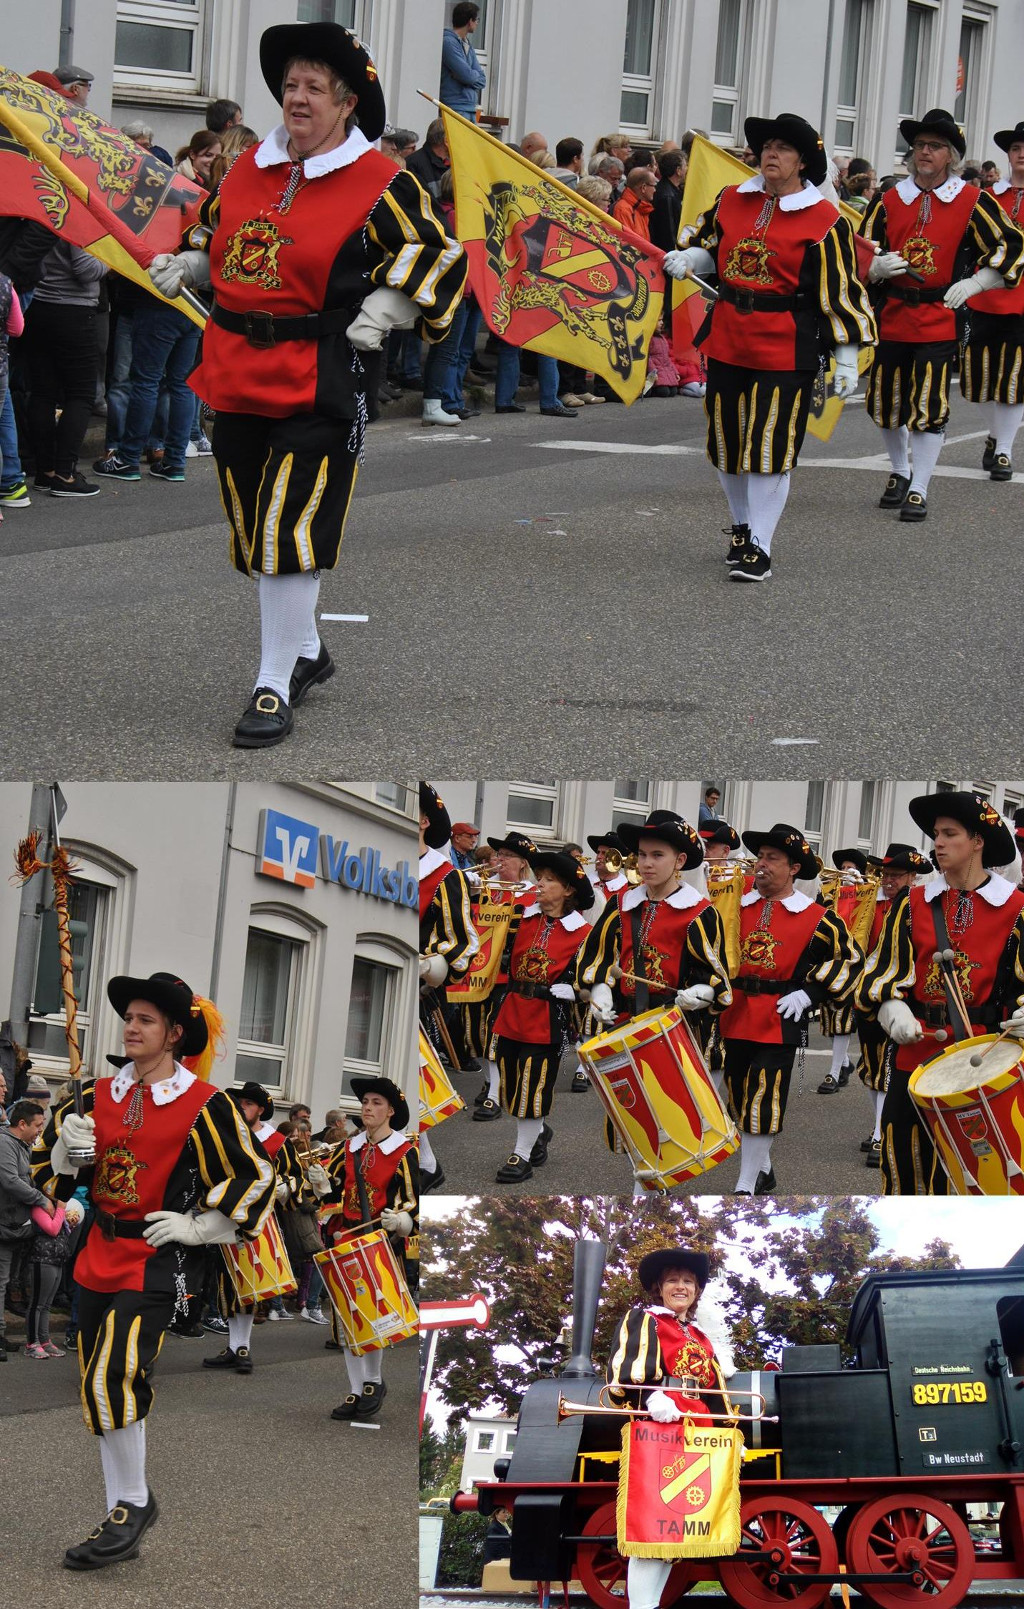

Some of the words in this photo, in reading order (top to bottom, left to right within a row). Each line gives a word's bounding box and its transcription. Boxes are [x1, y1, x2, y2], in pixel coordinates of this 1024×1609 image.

[320, 834, 419, 908] Volksb
[914, 1366, 939, 1374] Deutsche
[913, 1381, 987, 1404] 897159
[635, 1428, 733, 1448] Musikverein
[929, 1454, 942, 1465] Bw
[943, 1452, 984, 1464] Neustadt
[656, 1519, 711, 1536] TAMM
